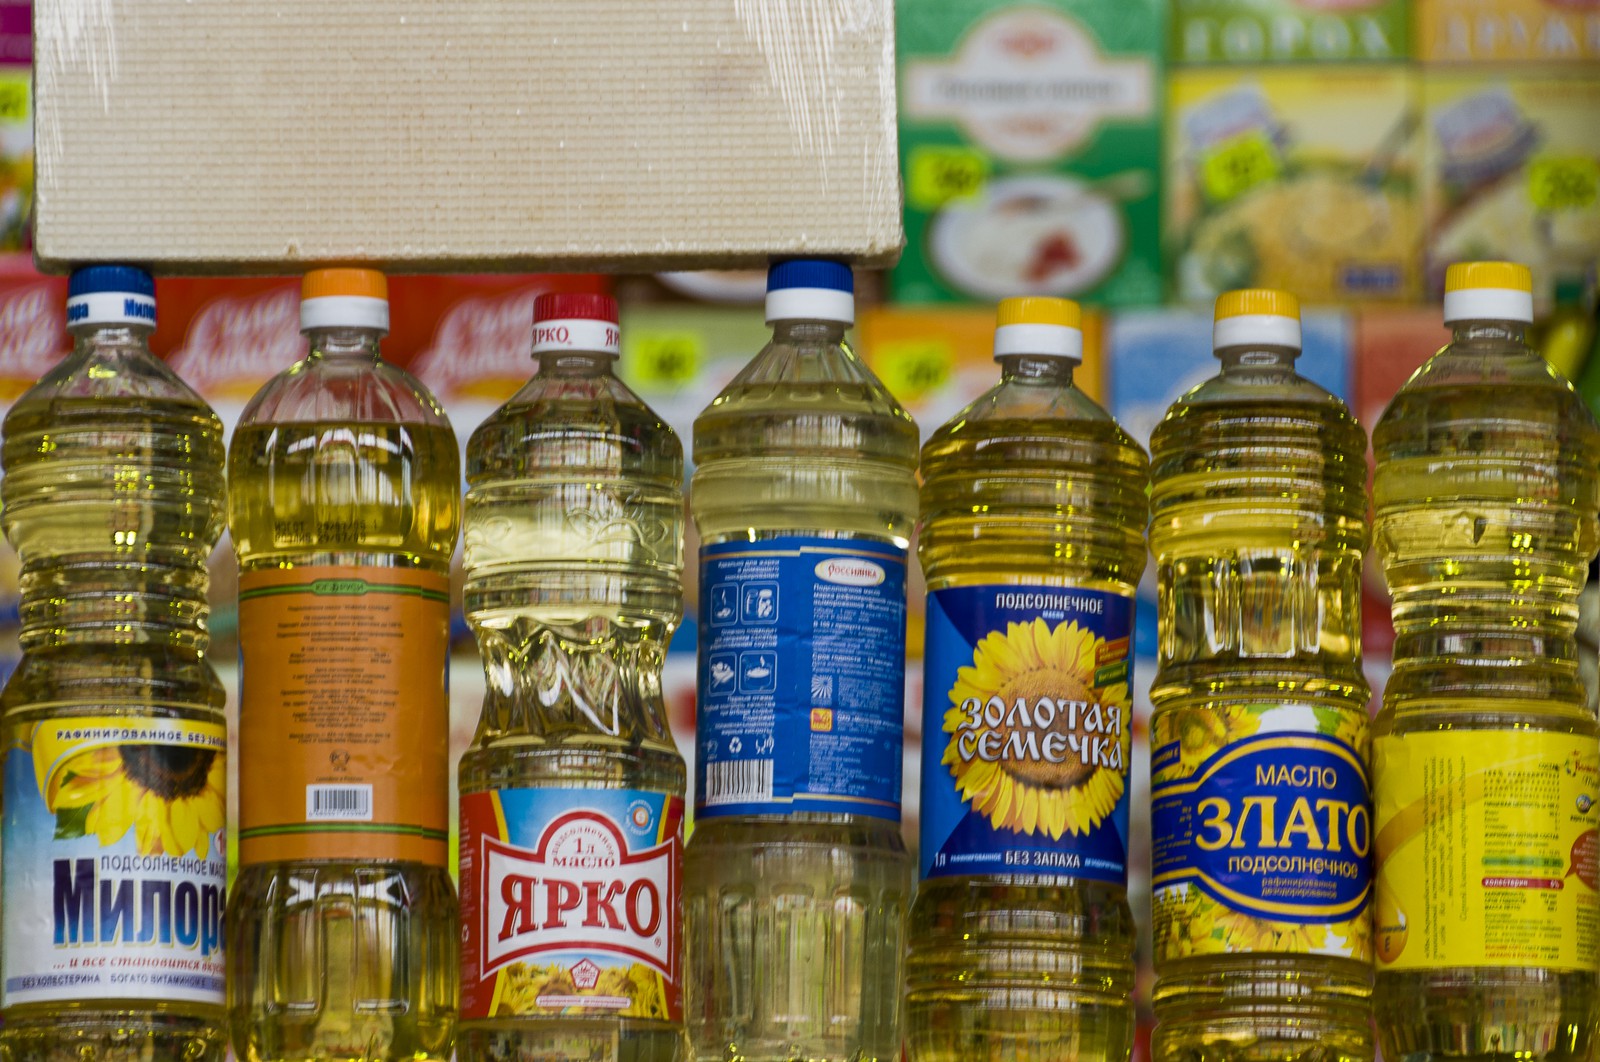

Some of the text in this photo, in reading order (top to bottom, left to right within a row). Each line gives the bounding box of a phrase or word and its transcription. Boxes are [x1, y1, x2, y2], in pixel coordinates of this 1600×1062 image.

[996, 593, 1104, 615] ПОДСОЛНЕЧНОЕ
[957, 696, 1122, 737] ЗОЛОТАЯ
[57, 728, 182, 741] РАФИНИРОВАННОЕ
[188, 732, 206, 743] БЕЗ
[957, 729, 1124, 770] СЕМЕЧКА
[1256, 764, 1338, 789] МАСЛО
[1195, 796, 1371, 858] ЗЛАТО
[101, 855, 207, 876] ПОДСОЛНЕЧНОЕ
[1005, 850, 1030, 865] БЕЗ
[1034, 851, 1081, 868] ЗАПАХА
[1228, 855, 1358, 879] подсолнечное
[498, 873, 663, 943] ЯРКО
[70, 957, 77, 968] и
[82, 956, 106, 967] все
[110, 956, 201, 971] становится
[36, 974, 101, 987] ХОЛЕСТЕРИНА
[110, 973, 148, 985] БОГАТО
